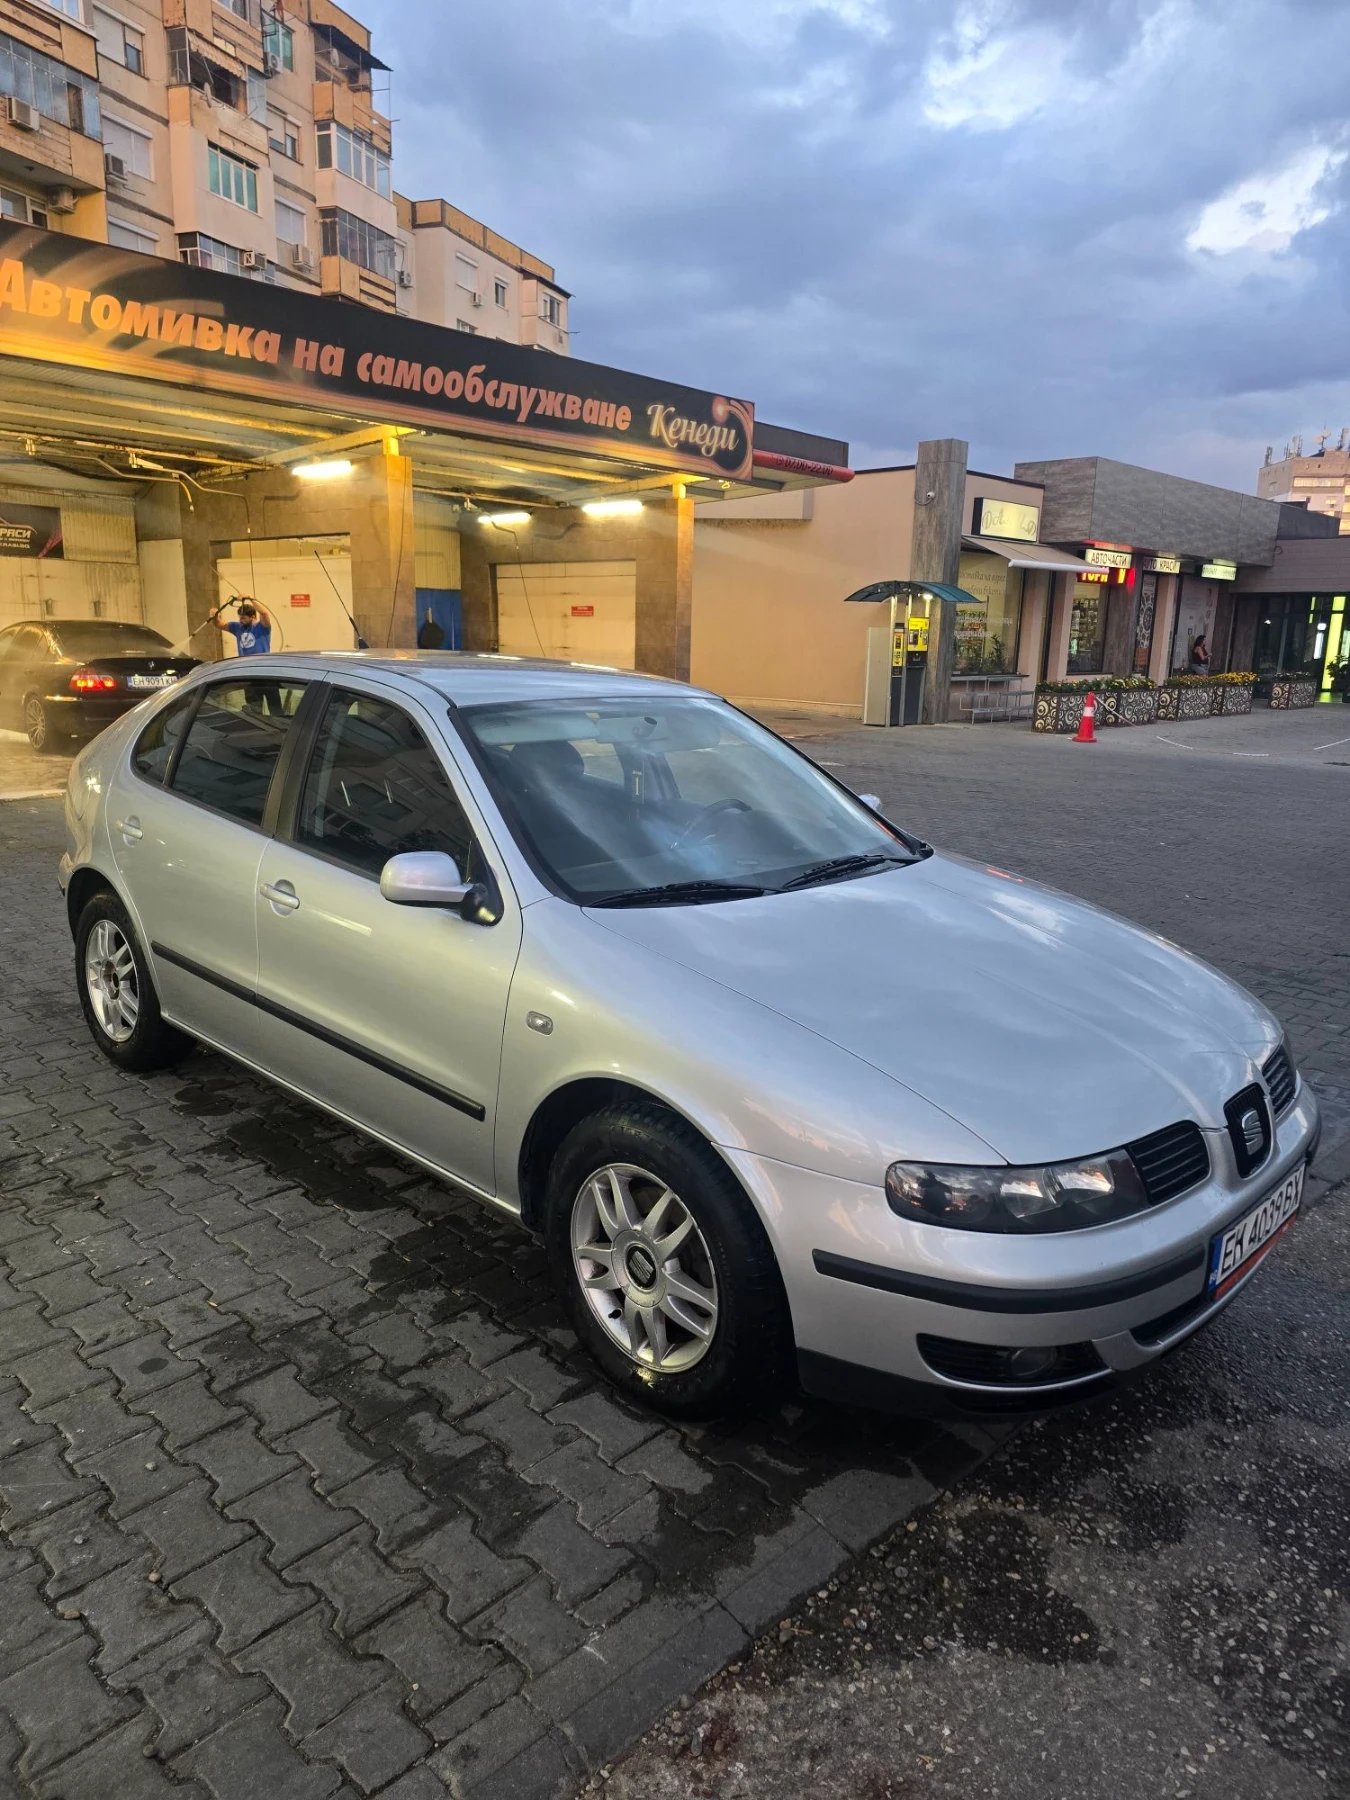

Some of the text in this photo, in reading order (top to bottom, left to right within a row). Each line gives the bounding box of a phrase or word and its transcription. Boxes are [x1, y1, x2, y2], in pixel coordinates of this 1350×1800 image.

[0, 257, 632, 430] Автомивка на самообслужване
[647, 402, 740, 457] Кенеди
[1091, 552, 1128, 567] АВТОЧАСТИ
